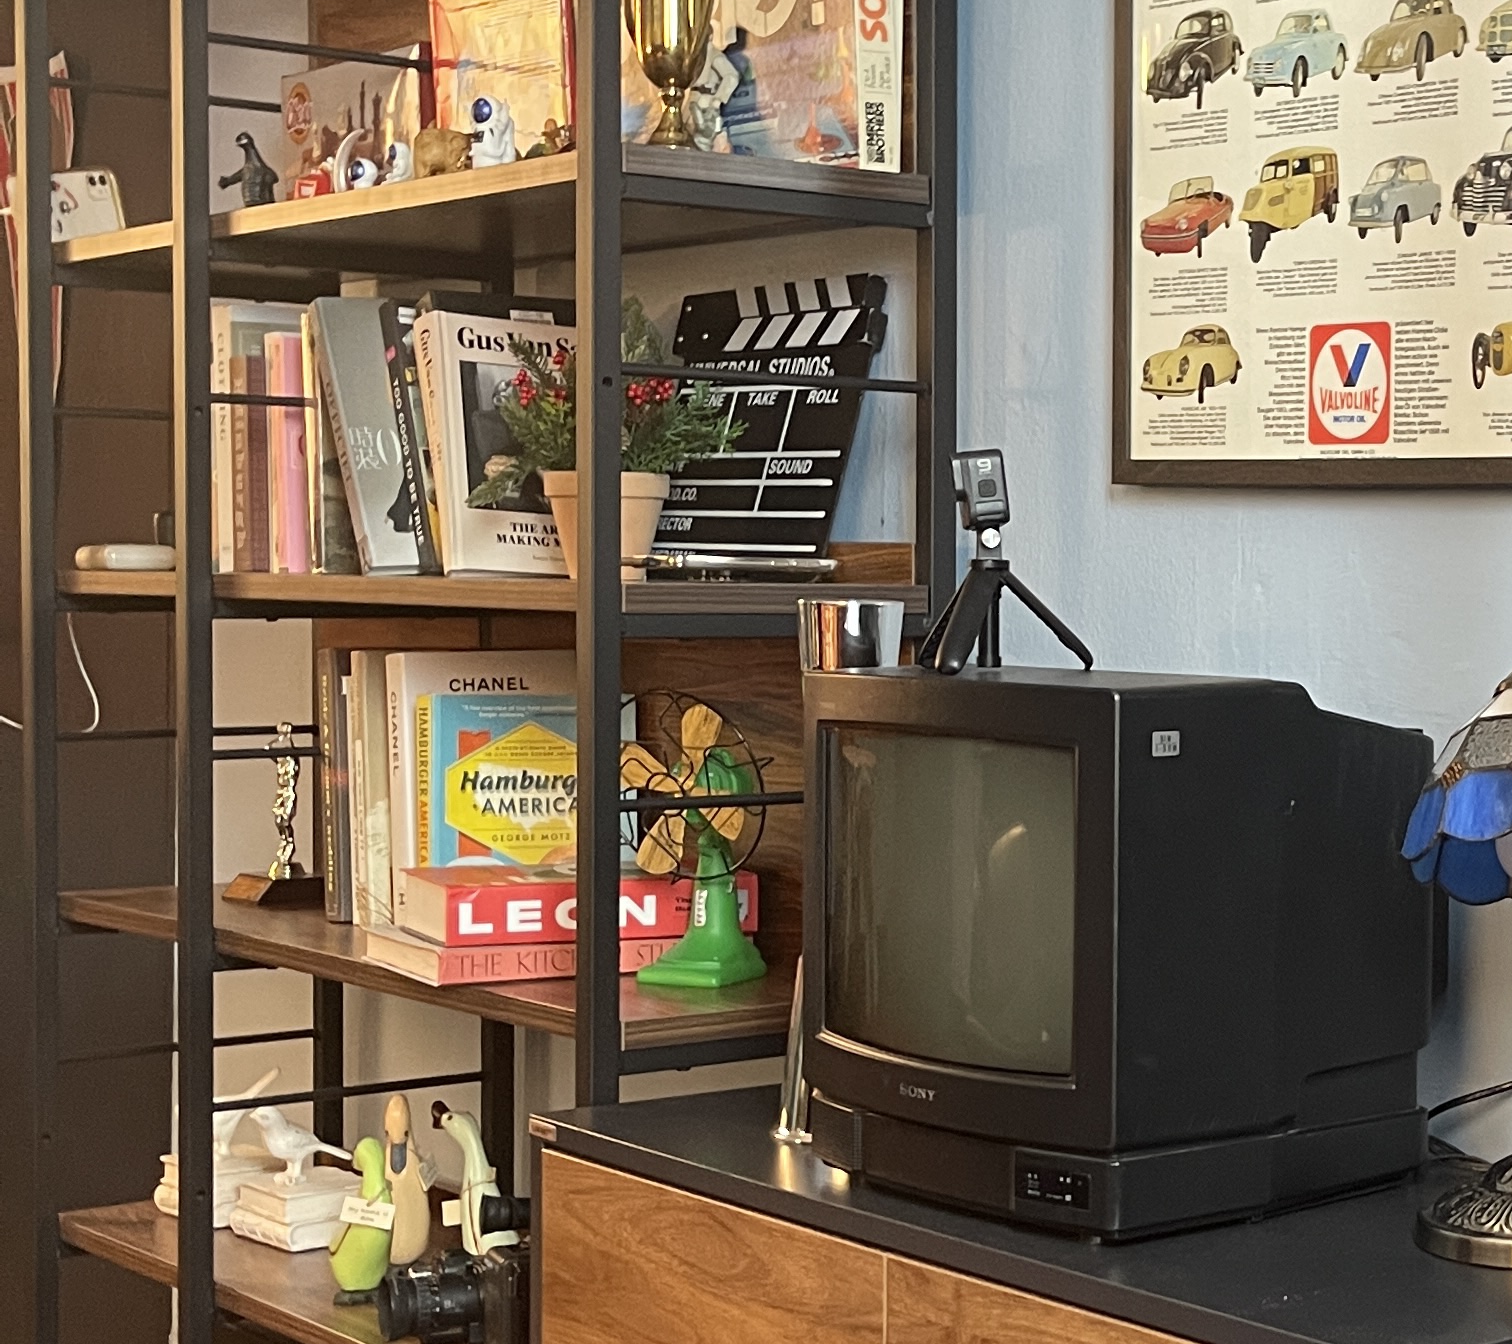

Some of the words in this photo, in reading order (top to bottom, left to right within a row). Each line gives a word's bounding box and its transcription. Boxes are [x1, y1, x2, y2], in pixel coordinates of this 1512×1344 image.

[457, 326, 505, 352] Gus
[392, 378, 402, 410] TOO
[747, 392, 778, 406] TAKE
[806, 389, 839, 404] ROLL
[1320, 386, 1379, 414] VALVOLINE
[1333, 415, 1355, 423] MOTOR
[398, 412, 410, 457] GOOD
[405, 458, 413, 480] TO
[768, 459, 813, 474] SOUND
[408, 481, 418, 505] BE
[413, 506, 425, 547] TRUE
[510, 521, 537, 534] THE
[496, 533, 551, 547] MAKING
[448, 677, 530, 692] CHANEL
[389, 691, 400, 777] CHANEL
[418, 707, 429, 799] HAMBURGER
[418, 800, 429, 866] AMERICA
[491, 833, 535, 843] GEORGE
[540, 832, 571, 842] MOTZ
[459, 956, 502, 977] THE
[900, 1083, 935, 1101] SONY
